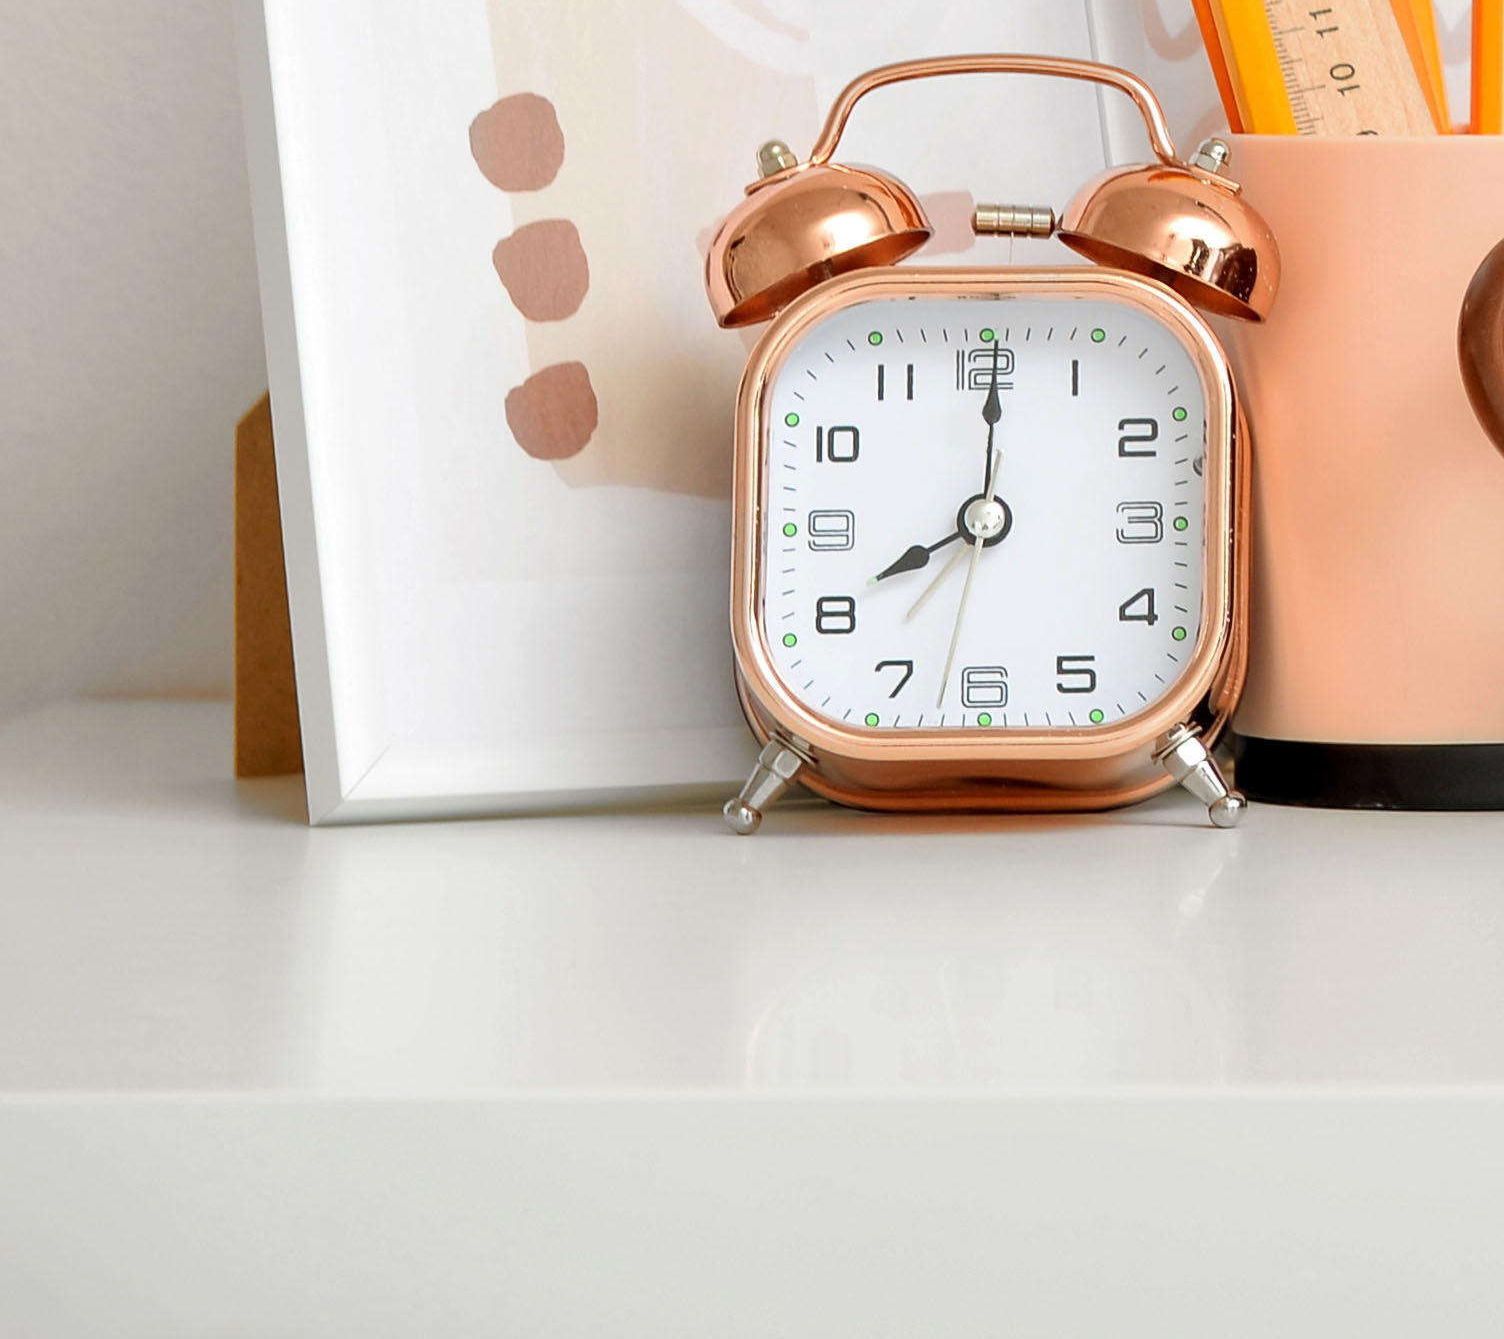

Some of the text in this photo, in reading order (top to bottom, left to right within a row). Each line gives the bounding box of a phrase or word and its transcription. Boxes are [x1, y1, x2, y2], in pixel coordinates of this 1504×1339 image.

[1308, 7, 1339, 39] 11
[1329, 63, 1361, 97] 10
[877, 363, 914, 402] 11
[955, 346, 1015, 392] 12
[1071, 359, 1079, 397] 1
[815, 425, 860, 463] 10
[1117, 417, 1159, 458] 2
[807, 509, 856, 552] 9
[1115, 500, 1164, 545] 3
[815, 595, 857, 635] 8
[1118, 587, 1159, 627] 4
[874, 659, 914, 699] 7
[960, 665, 1009, 709] 6
[1056, 655, 1097, 694] 5
